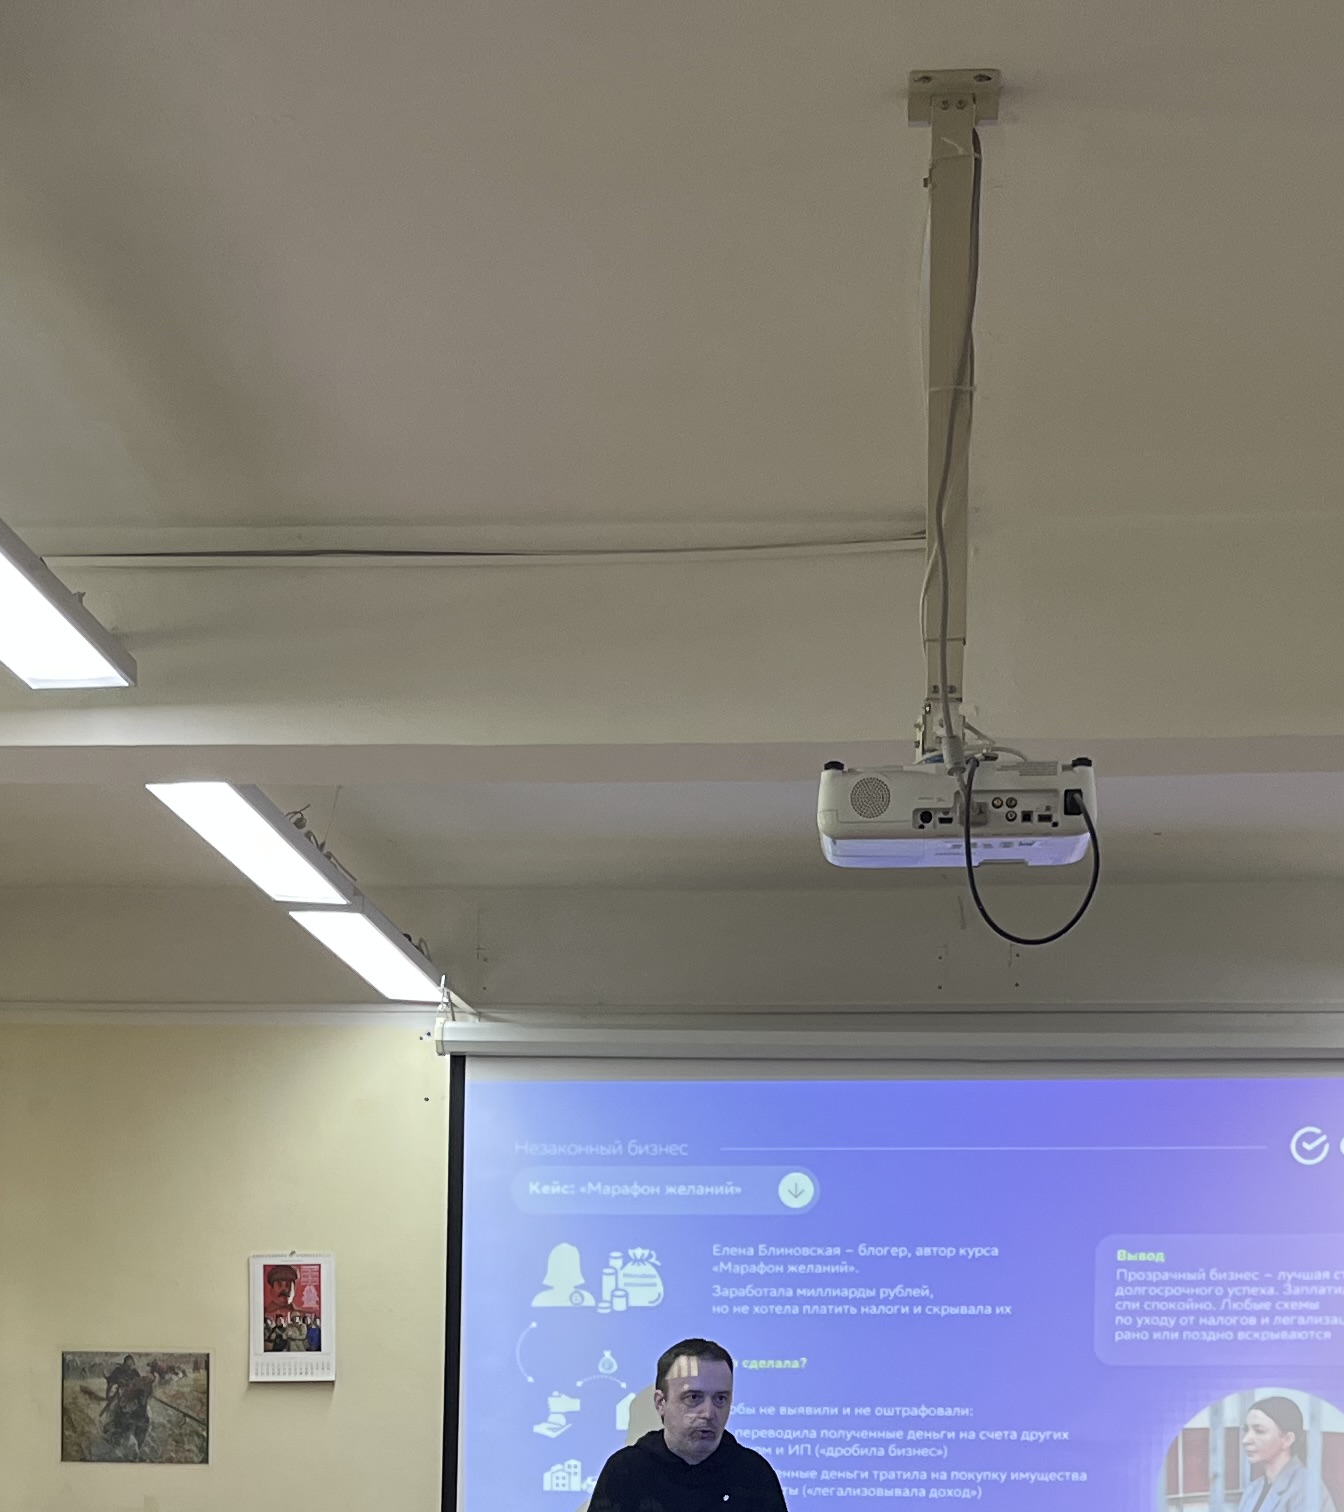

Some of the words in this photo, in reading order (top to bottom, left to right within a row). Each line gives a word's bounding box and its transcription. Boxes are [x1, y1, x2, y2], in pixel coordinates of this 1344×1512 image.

[514, 1139, 623, 1156] Незаконный
[627, 1139, 688, 1156] бизнес
[529, 1181, 575, 1196] Кейс:
[579, 1182, 660, 1199] «Марафон
[664, 1181, 743, 1196] желаний»
[712, 1244, 755, 1257] Елена
[758, 1244, 842, 1257] Блиновская
[858, 1243, 912, 1258] блогер,
[915, 1246, 956, 1259] автор
[959, 1246, 999, 1259] курса
[1117, 1250, 1165, 1263] Вывод
[712, 1262, 784, 1276] «Марафон
[787, 1260, 859, 1275] желаний».
[1116, 1268, 1206, 1283] Прозрачный
[1209, 1269, 1259, 1281] бизнес
[1277, 1271, 1330, 1283] лучшая
[712, 1284, 793, 1299] Заработала
[796, 1286, 876, 1300] миллиарды
[879, 1284, 934, 1300] рублей,
[1115, 1285, 1224, 1299] долгосрочного
[1227, 1285, 1279, 1299] успеха.
[712, 1305, 729, 1315] но
[732, 1305, 749, 1315] не
[752, 1305, 799, 1315] хотела
[802, 1305, 857, 1315] платить
[861, 1305, 909, 1315] налоги
[925, 1305, 992, 1318] скрывала
[995, 1305, 1012, 1315] их
[1115, 1301, 1140, 1311] спи
[1144, 1299, 1216, 1313] спокойно.
[1220, 1299, 1273, 1311] Любые
[1275, 1301, 1320, 1312] схемы
[1115, 1315, 1132, 1326] по
[1136, 1315, 1176, 1329] уходу
[1179, 1315, 1196, 1326] от
[1199, 1315, 1257, 1327] налогов
[1115, 1330, 1149, 1343] рано
[1152, 1330, 1179, 1341] или
[1182, 1330, 1234, 1343] поздно
[1237, 1330, 1331, 1343] вскрываются
[742, 1357, 807, 1370] сделала?
[729, 1405, 755, 1418] обы
[759, 1406, 775, 1416] не
[779, 1406, 838, 1416] выявили
[854, 1407, 871, 1416] не
[875, 1405, 974, 1420] оштрафовали:
[821, 1430, 903, 1442] полученные
[907, 1430, 955, 1442] деньги
[959, 1430, 975, 1440] на
[979, 1430, 1017, 1441] счета
[1020, 1430, 1069, 1443] других
[788, 1445, 811, 1456] ИП
[815, 1444, 885, 1460] («дробила
[888, 1444, 948, 1459] бизнес»)
[778, 1470, 817, 1480] енные
[821, 1469, 868, 1482] деньги
[872, 1470, 927, 1481] тратила
[931, 1471, 947, 1481] на
[951, 1471, 1007, 1483] покупку
[1010, 1471, 1087, 1483] имущества
[803, 1485, 926, 1500] («легализовывала
[929, 1485, 983, 1500] доход»)
